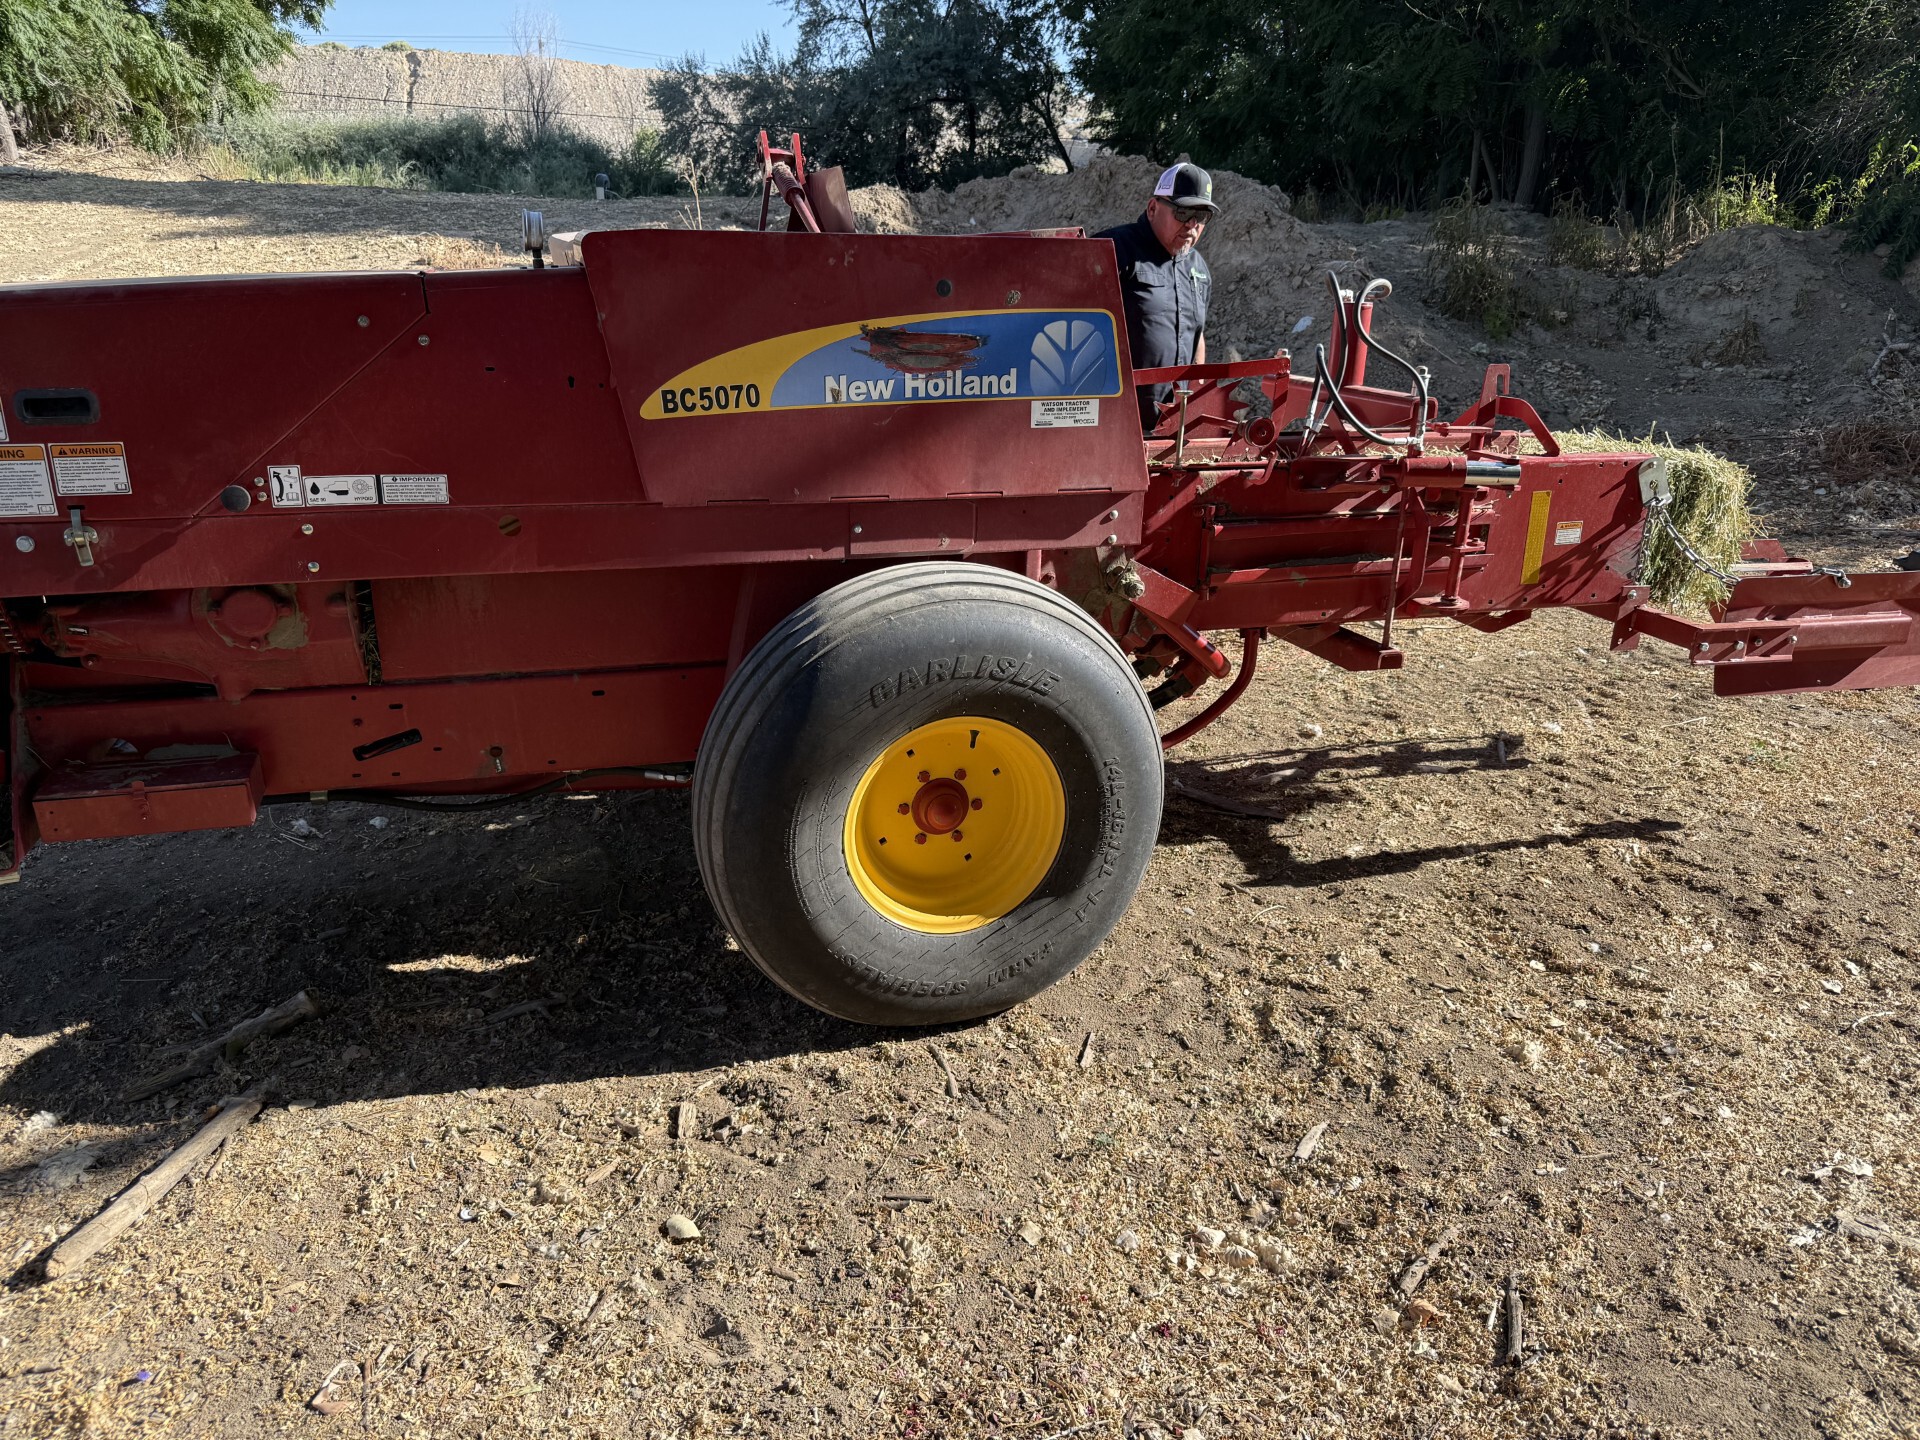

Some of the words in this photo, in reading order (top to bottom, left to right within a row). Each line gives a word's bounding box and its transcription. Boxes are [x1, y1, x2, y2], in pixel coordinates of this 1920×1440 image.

[661, 384, 760, 413] BC5070
[825, 375, 895, 403] New
[905, 367, 1017, 398] Holland
[69, 447, 116, 455] WARNING
[869, 654, 1063, 708] CARLISLE
